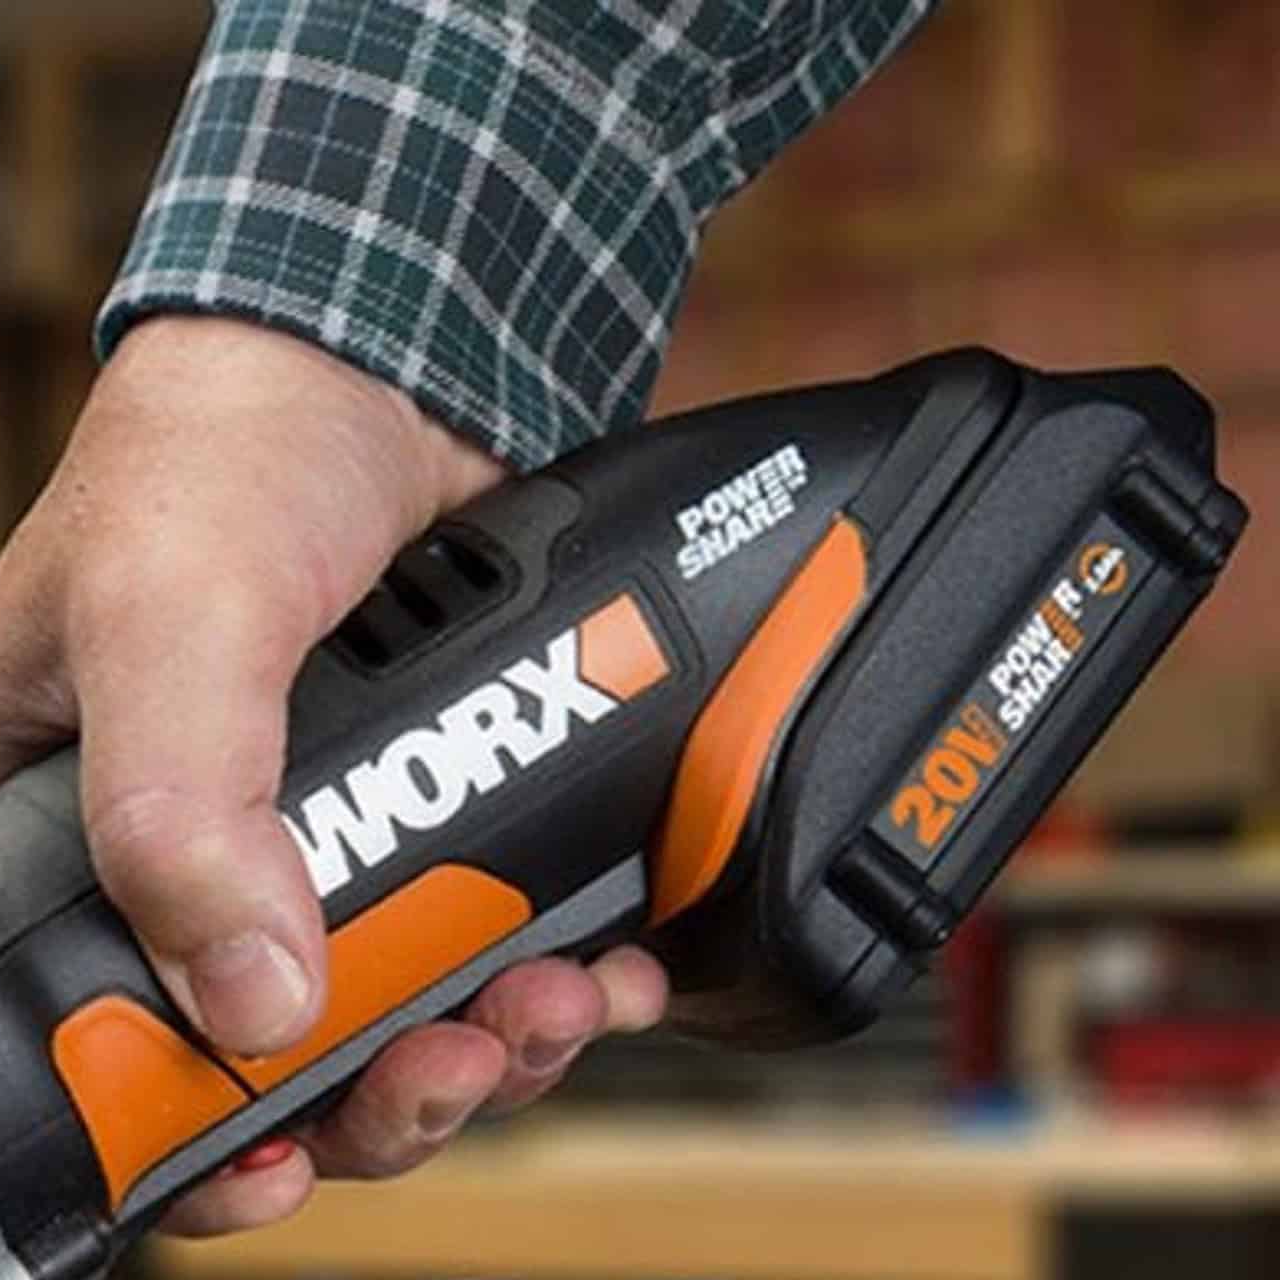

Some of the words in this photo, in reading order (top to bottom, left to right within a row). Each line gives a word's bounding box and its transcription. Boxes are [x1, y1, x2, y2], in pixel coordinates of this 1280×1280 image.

[676, 443, 807, 541] POWER
[987, 578, 1083, 696] POWER
[280, 626, 618, 900] WORX
